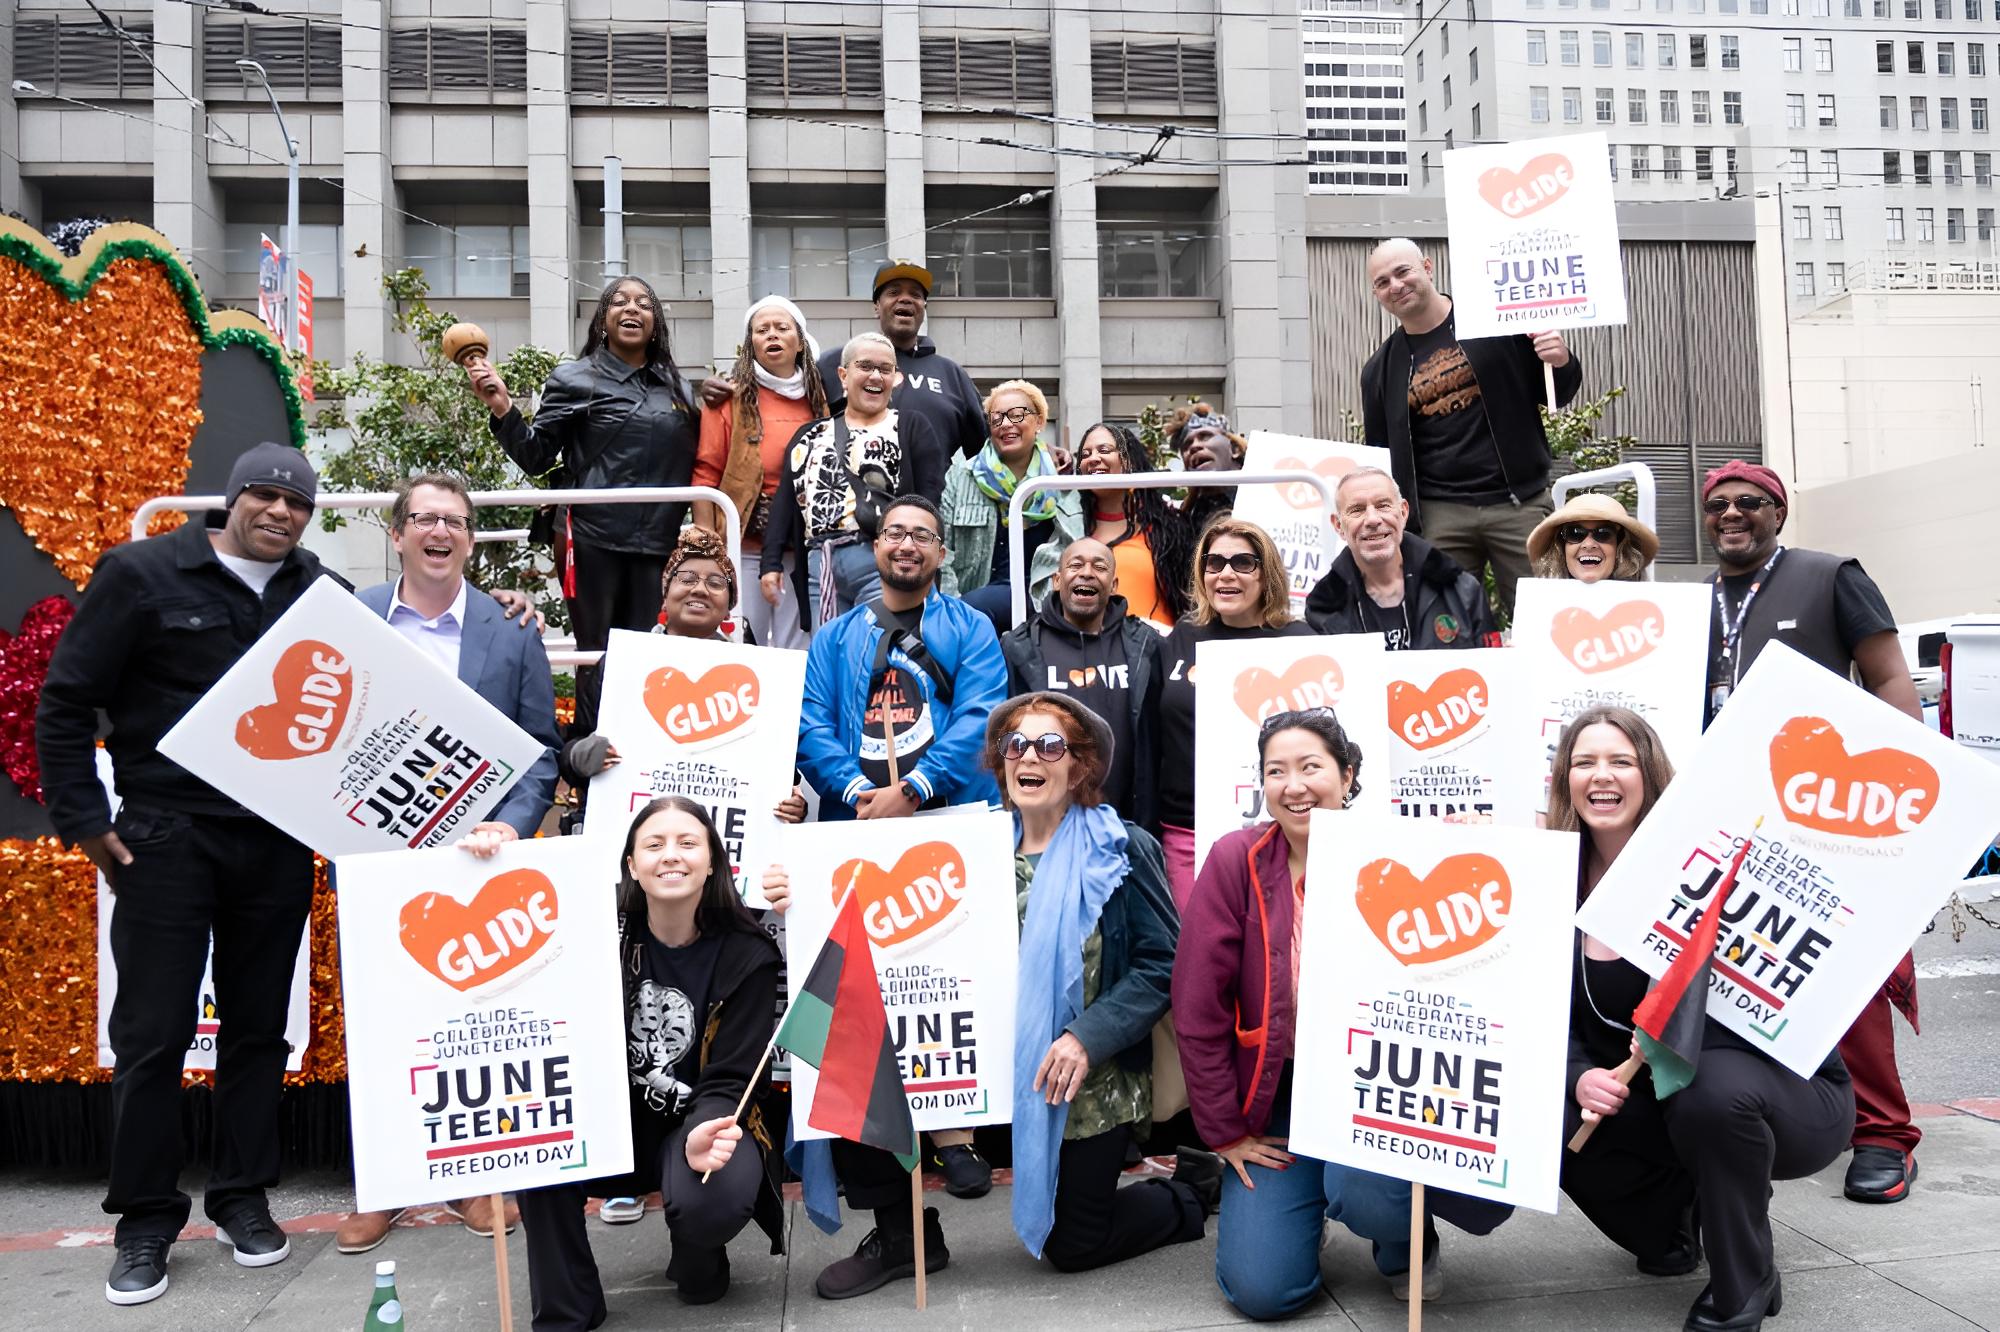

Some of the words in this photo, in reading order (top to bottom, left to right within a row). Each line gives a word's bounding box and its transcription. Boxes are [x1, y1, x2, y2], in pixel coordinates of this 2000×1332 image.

[1502, 167, 1572, 214] GLIDE
[1494, 255, 1585, 286] JUNE
[1495, 279, 1586, 302] TEENTH
[1573, 617, 1661, 669] GLIDE
[288, 651, 350, 751] GLIDE
[666, 683, 758, 737] GLIDE
[1403, 685, 1489, 744] GLIDE
[366, 725, 463, 829] JUNE
[388, 746, 482, 839] TEENTH
[474, 767, 500, 794] DAY
[1783, 772, 1926, 831] GLIDE
[1769, 841, 1822, 879] GLIDE
[863, 861, 966, 940] GLIDE
[1721, 849, 1833, 922] JNETEENTH
[437, 891, 558, 982] GLIDE
[1386, 880, 1510, 955] GLIDE
[1680, 867, 1833, 975] JUNE
[885, 965, 931, 979] GLIDE
[1642, 932, 1735, 999] FREOM
[1735, 994, 1777, 1024] DAY
[464, 1007, 518, 1026] GLIDE
[1373, 1000, 1487, 1030] CELEBRATES
[1403, 990, 1456, 1009] GLIDE
[432, 1034, 552, 1060] JUNETEENTH
[433, 1019, 551, 1045] CELEBRATES
[894, 1010, 977, 1052] UNE
[1371, 1015, 1488, 1047] JUNETEENTH
[422, 1055, 573, 1113] JUNE
[896, 1049, 977, 1080] ENTH
[1354, 1039, 1502, 1106] JUNE
[424, 1098, 574, 1143] TEENTH
[944, 1091, 977, 1109] DAY
[1354, 1085, 1499, 1137] TEENTH
[429, 1152, 529, 1180] FREEDOM
[536, 1144, 575, 1165] DAY
[1352, 1129, 1448, 1165] FREEDOM
[1455, 1147, 1495, 1174] DAY
